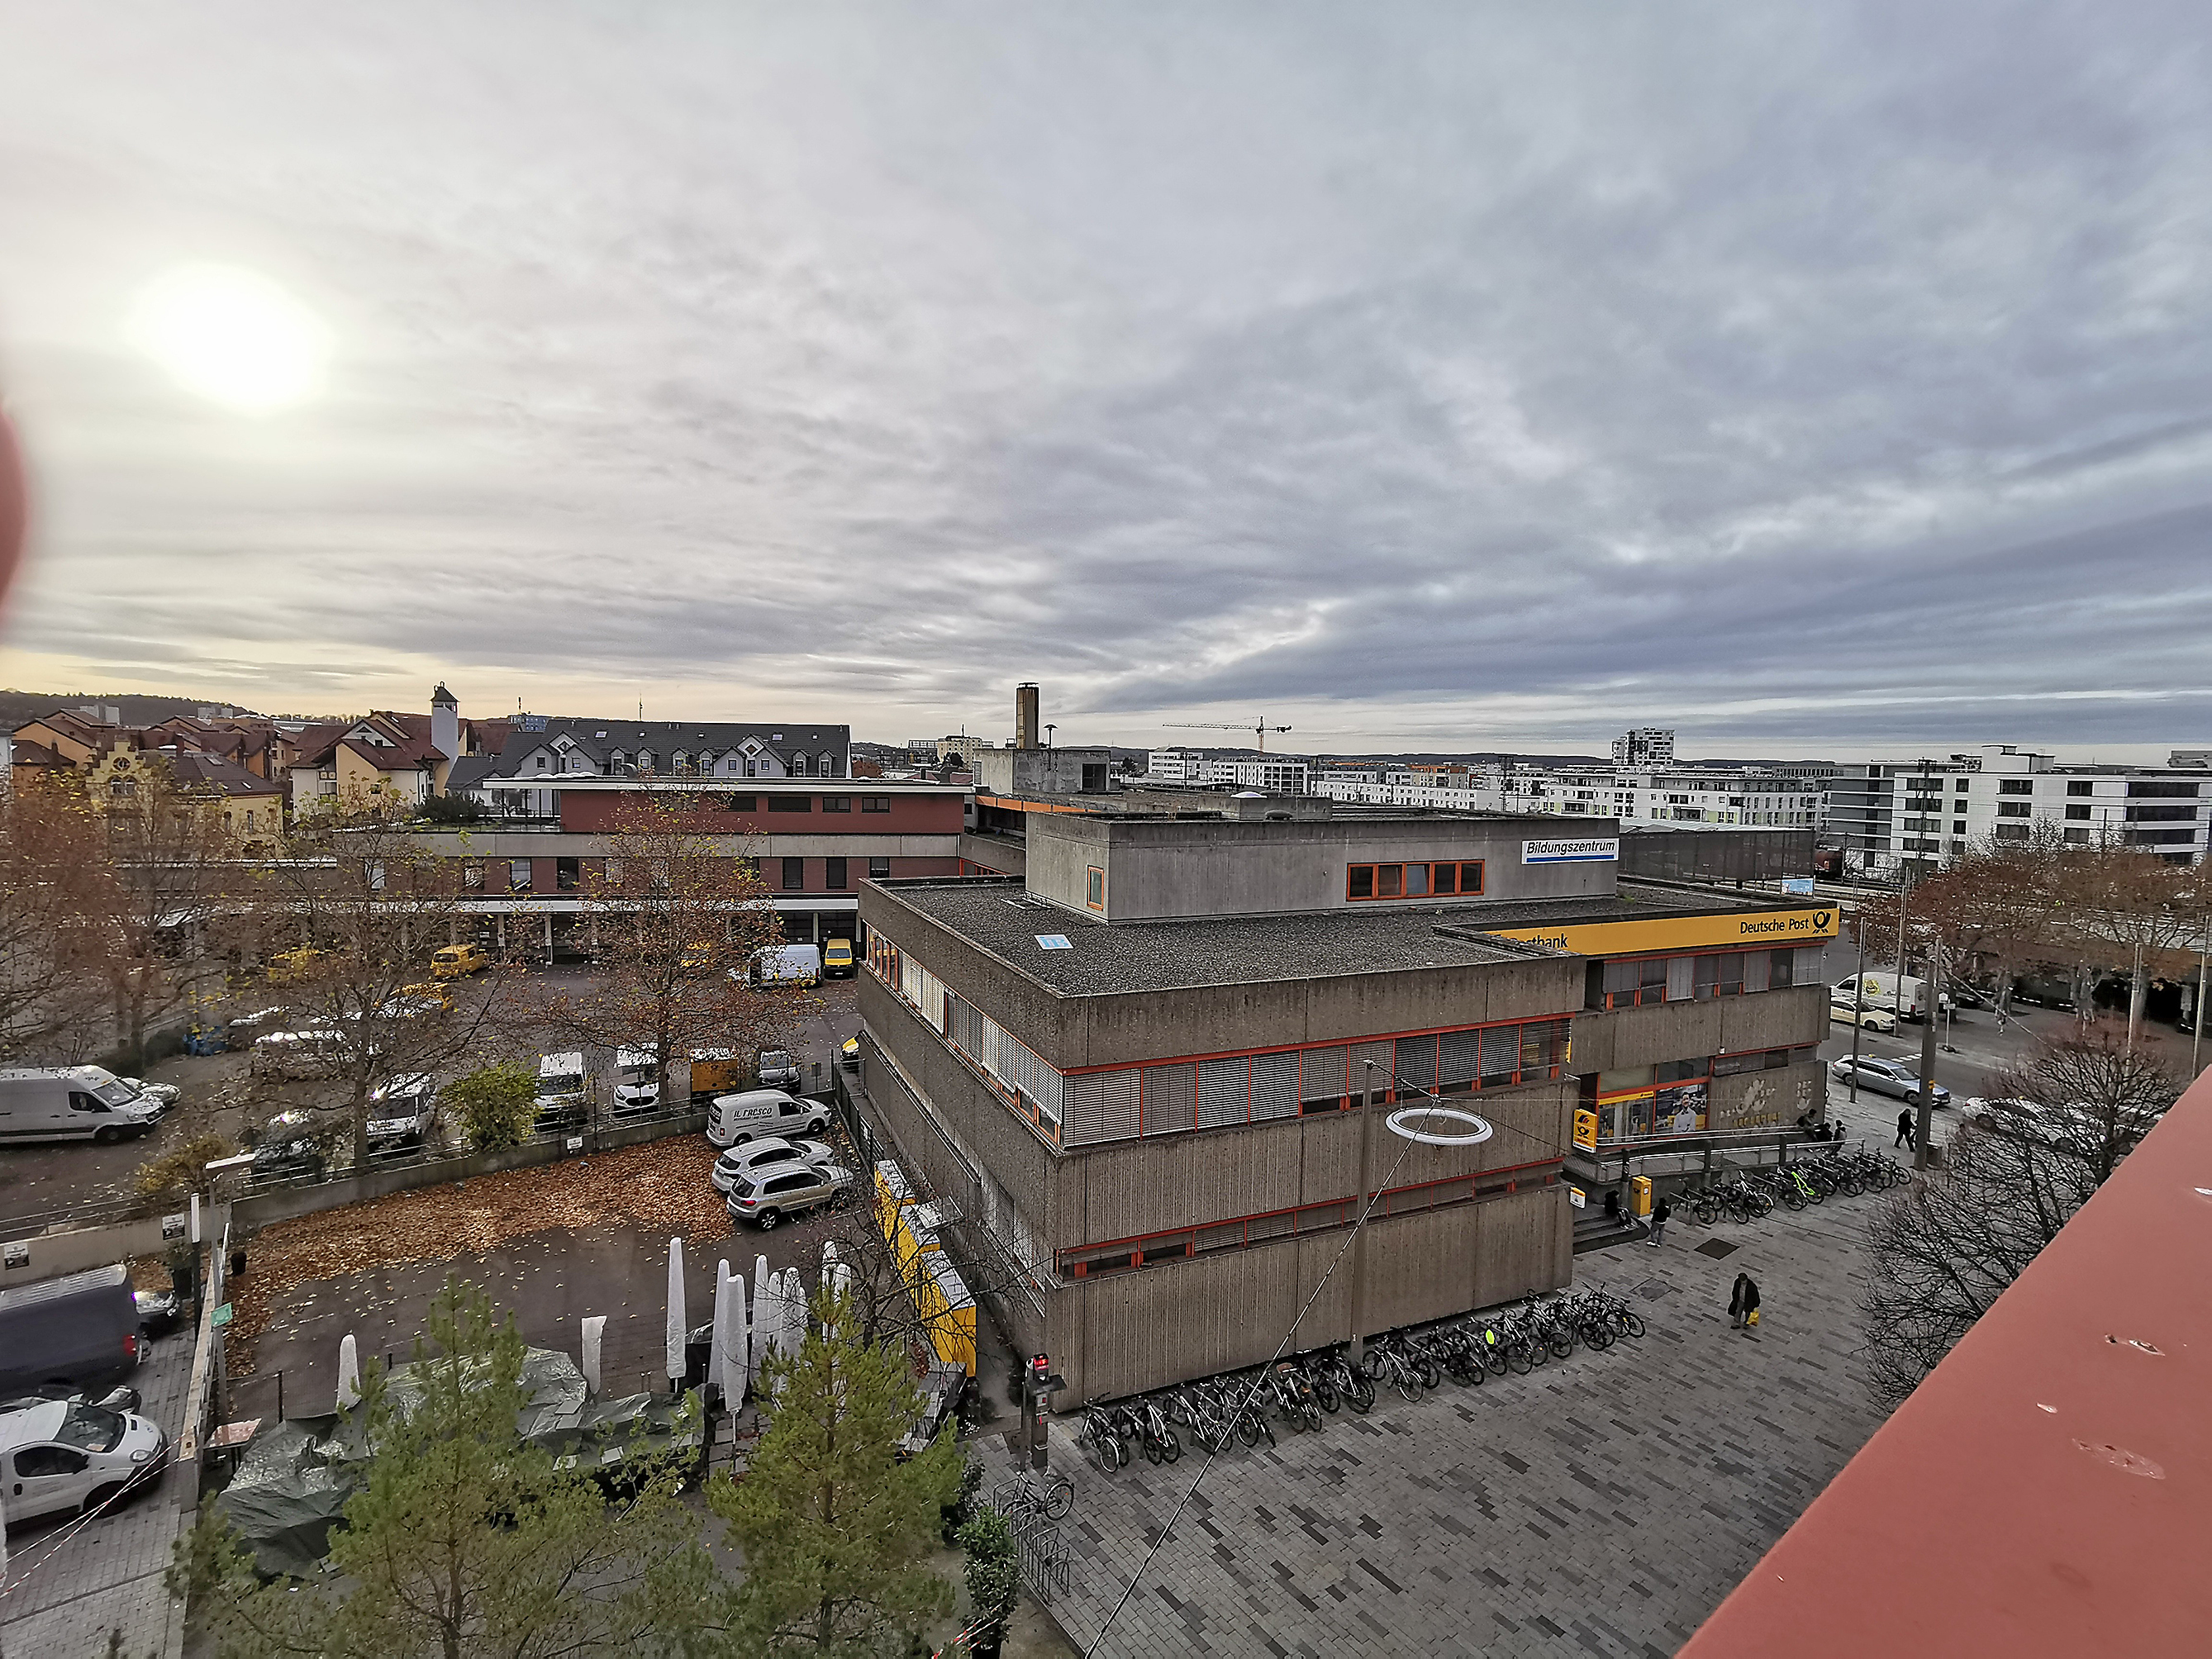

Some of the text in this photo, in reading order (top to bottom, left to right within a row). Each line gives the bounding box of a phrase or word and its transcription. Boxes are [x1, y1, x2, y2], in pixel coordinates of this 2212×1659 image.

[1527, 841, 1615, 855] Bildungszentrum
[1740, 918, 1809, 934] Deutsche Post
